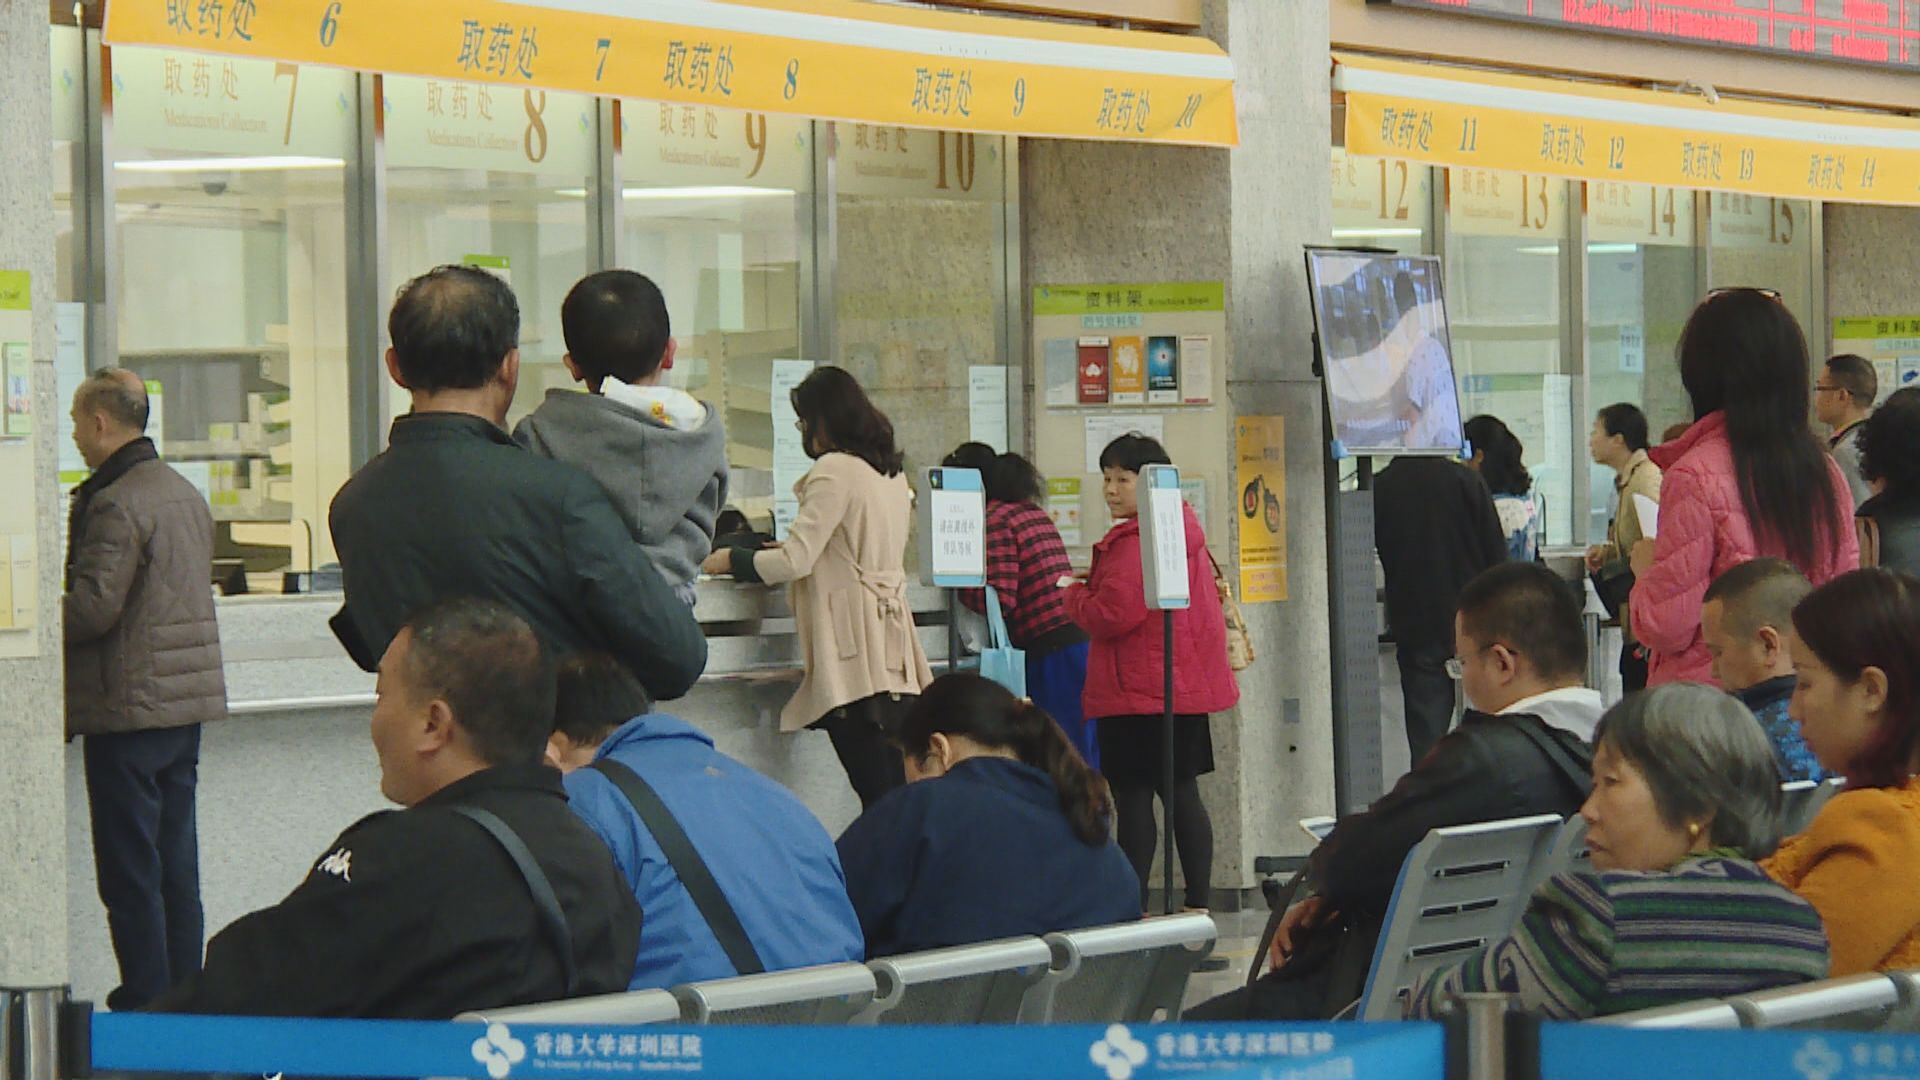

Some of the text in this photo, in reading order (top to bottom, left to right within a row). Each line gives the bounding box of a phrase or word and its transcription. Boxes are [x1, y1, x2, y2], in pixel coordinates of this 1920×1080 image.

[166, 0, 341, 47] 取药处 6
[457, 20, 611, 81] 取药处 7
[664, 40, 799, 100] 取药处 8
[164, 57, 239, 100] 取药处
[427, 81, 492, 120] 取药处
[912, 67, 1026, 117] 取药处 9
[274, 62, 299, 146] 7
[524, 88, 547, 163] 8
[660, 103, 718, 139] 取药处
[1097, 88, 1202, 132] 取药处 10
[745, 112, 766, 179] 9
[1381, 108, 1477, 151] 取药处 11
[1541, 123, 1625, 169] 取药处 12
[936, 131, 975, 192] 10
[1462, 169, 1501, 197] 取药处
[1682, 142, 1755, 180] 取药处 13
[1807, 154, 1876, 191] 取药处 14
[1378, 159, 1408, 220] 12
[1520, 175, 1549, 229] 13
[1649, 186, 1676, 237] 14
[1768, 196, 1794, 245] 15
[1087, 289, 1142, 309] 资料架
[534, 1033, 702, 1057] 香港大学深圳医院
